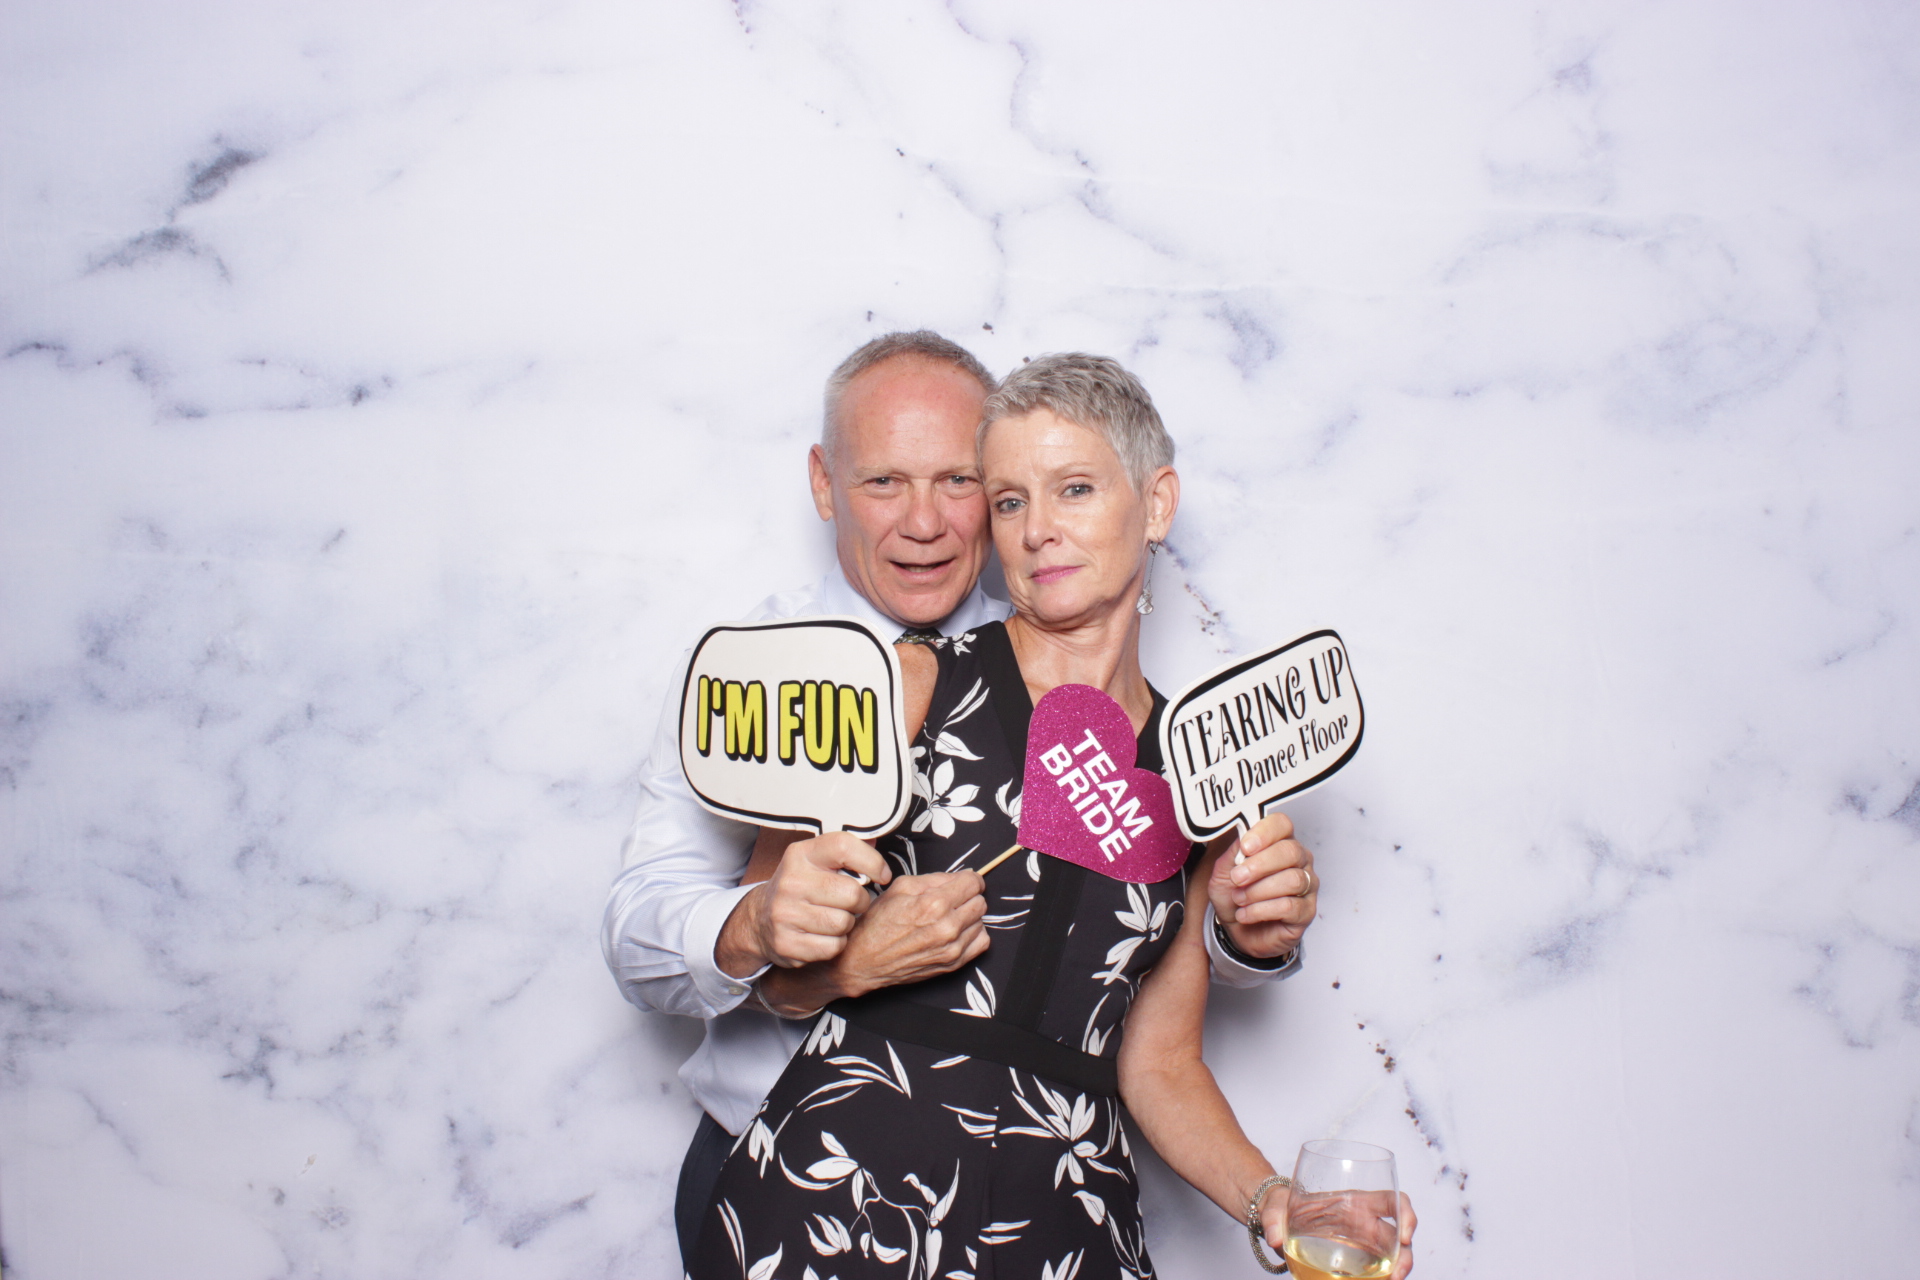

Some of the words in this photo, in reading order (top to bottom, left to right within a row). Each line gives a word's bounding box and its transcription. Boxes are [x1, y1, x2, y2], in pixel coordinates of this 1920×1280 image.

[697, 674, 767, 764] I'M
[778, 680, 879, 774] FUN
[1174, 666, 1306, 777] TEARING
[1309, 646, 1343, 705] UP
[1194, 773, 1235, 818] The
[1236, 743, 1297, 797] Dance
[1298, 714, 1348, 761] Floor
[1039, 743, 1132, 863] BRIDE
[1072, 728, 1154, 839] TEAM
